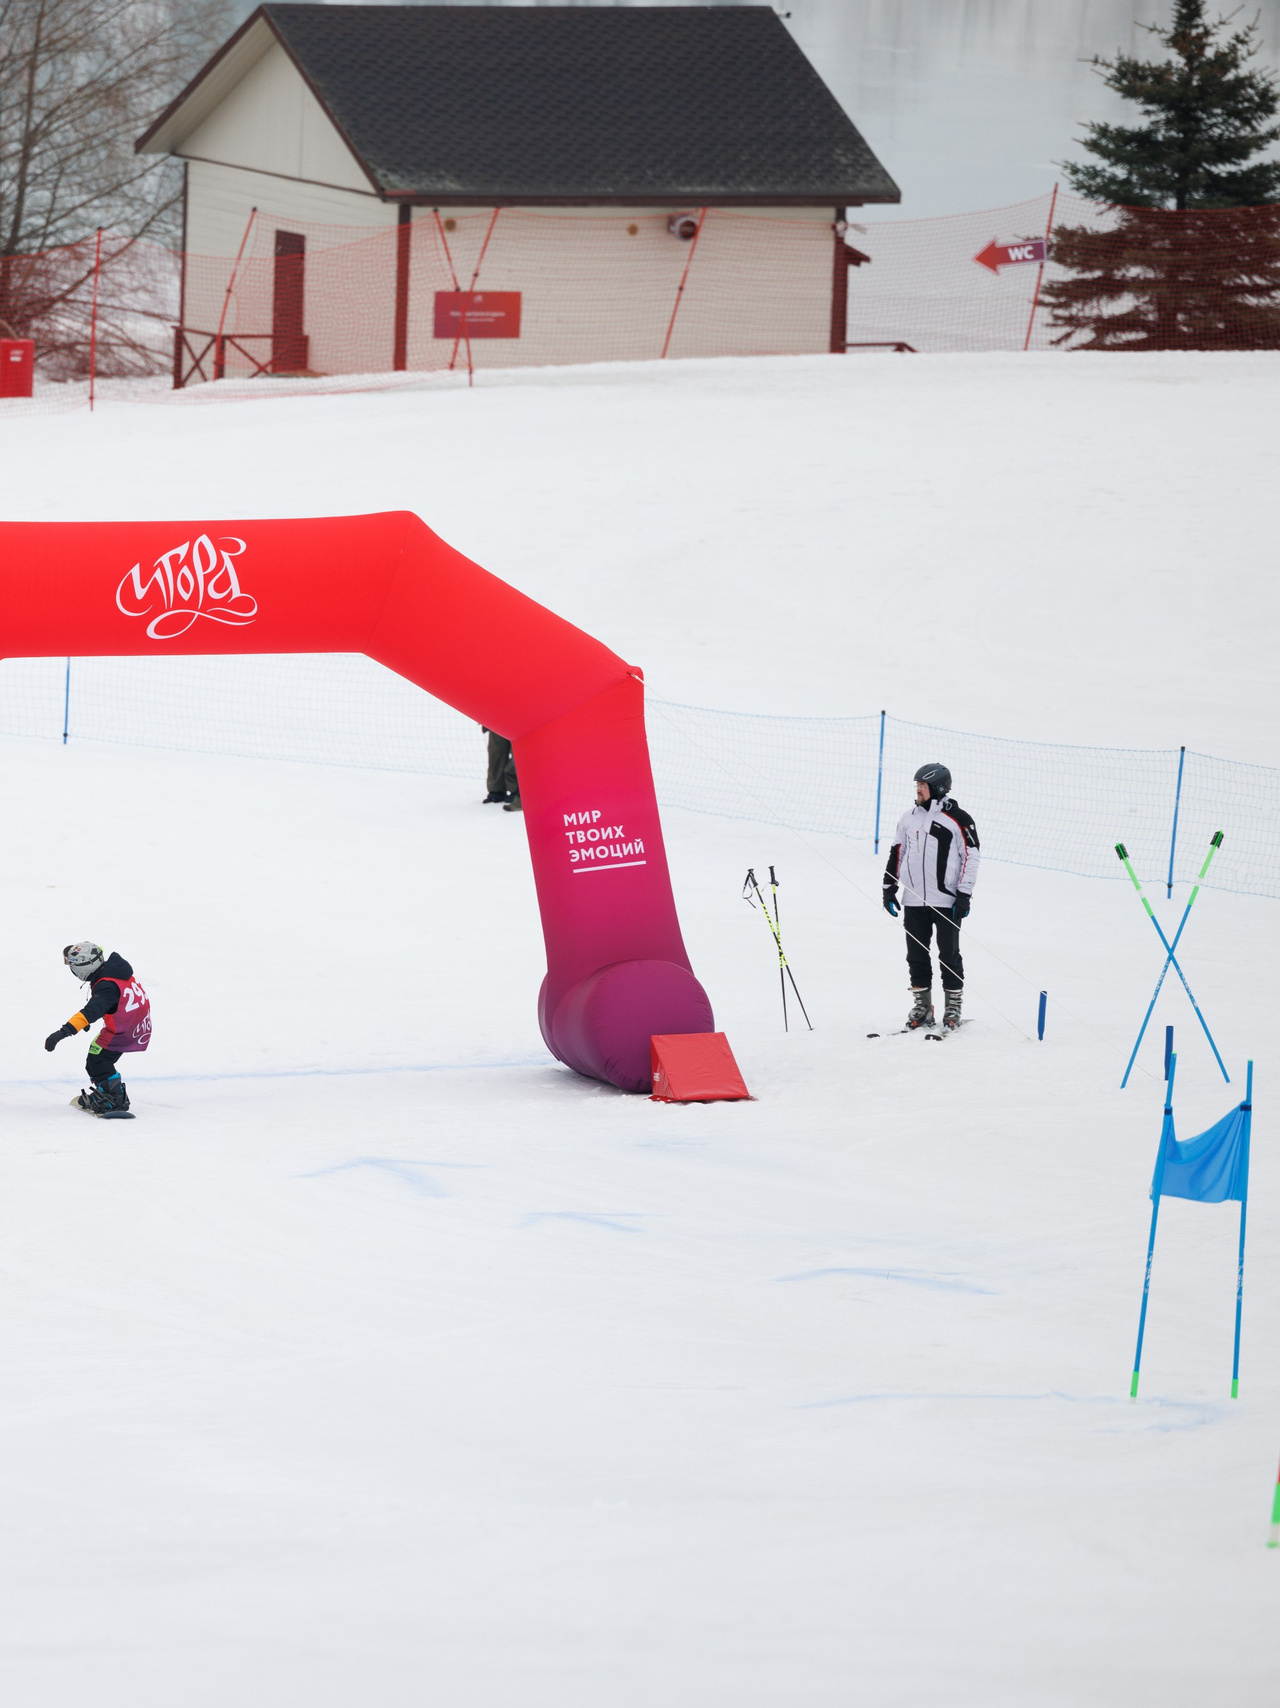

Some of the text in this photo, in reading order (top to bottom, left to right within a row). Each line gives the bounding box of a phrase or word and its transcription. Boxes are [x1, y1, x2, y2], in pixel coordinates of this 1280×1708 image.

[1007, 245, 1035, 261] WC
[564, 810, 601, 826] МИР
[565, 825, 625, 844] ТВОИХ
[569, 838, 645, 862] ЭМОЦИЙ
